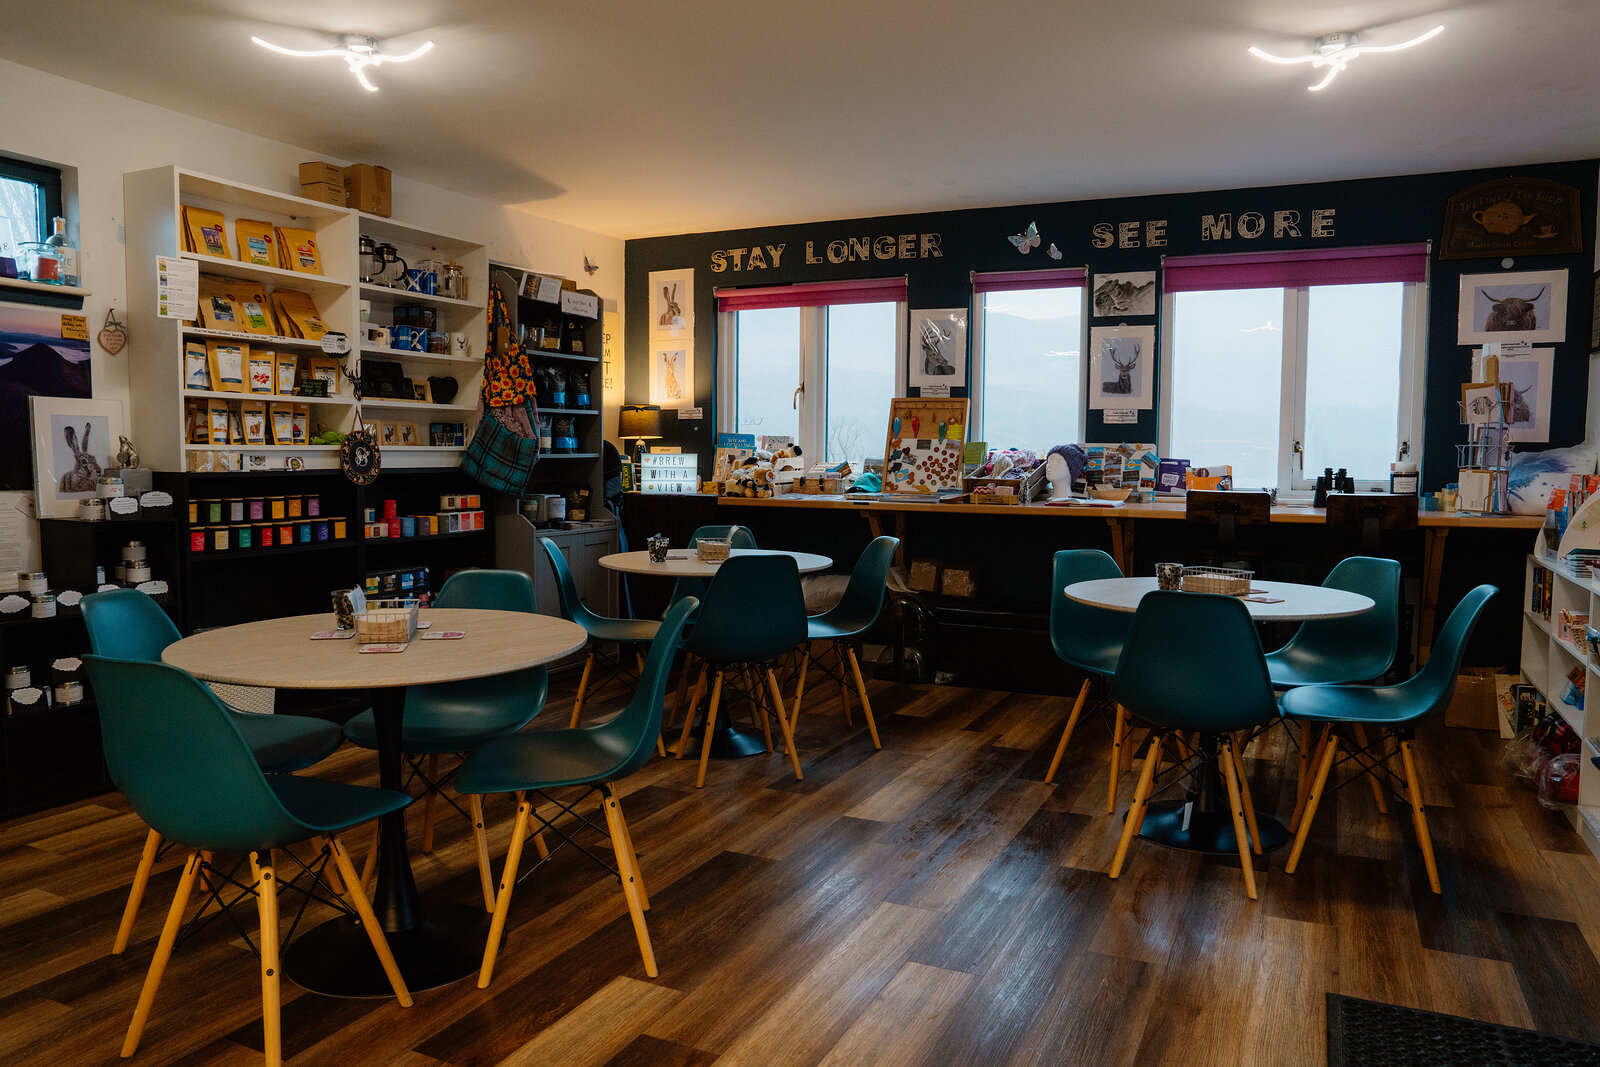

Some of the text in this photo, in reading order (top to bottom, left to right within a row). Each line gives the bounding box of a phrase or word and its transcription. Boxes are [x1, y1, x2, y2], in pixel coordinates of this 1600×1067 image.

[1091, 208, 1336, 249] SEE MORE
[709, 232, 944, 273] STAY LONGER
[652, 456, 685, 465] #BREW
[650, 469, 688, 479] WITH A
[657, 483, 683, 493] VIEW
